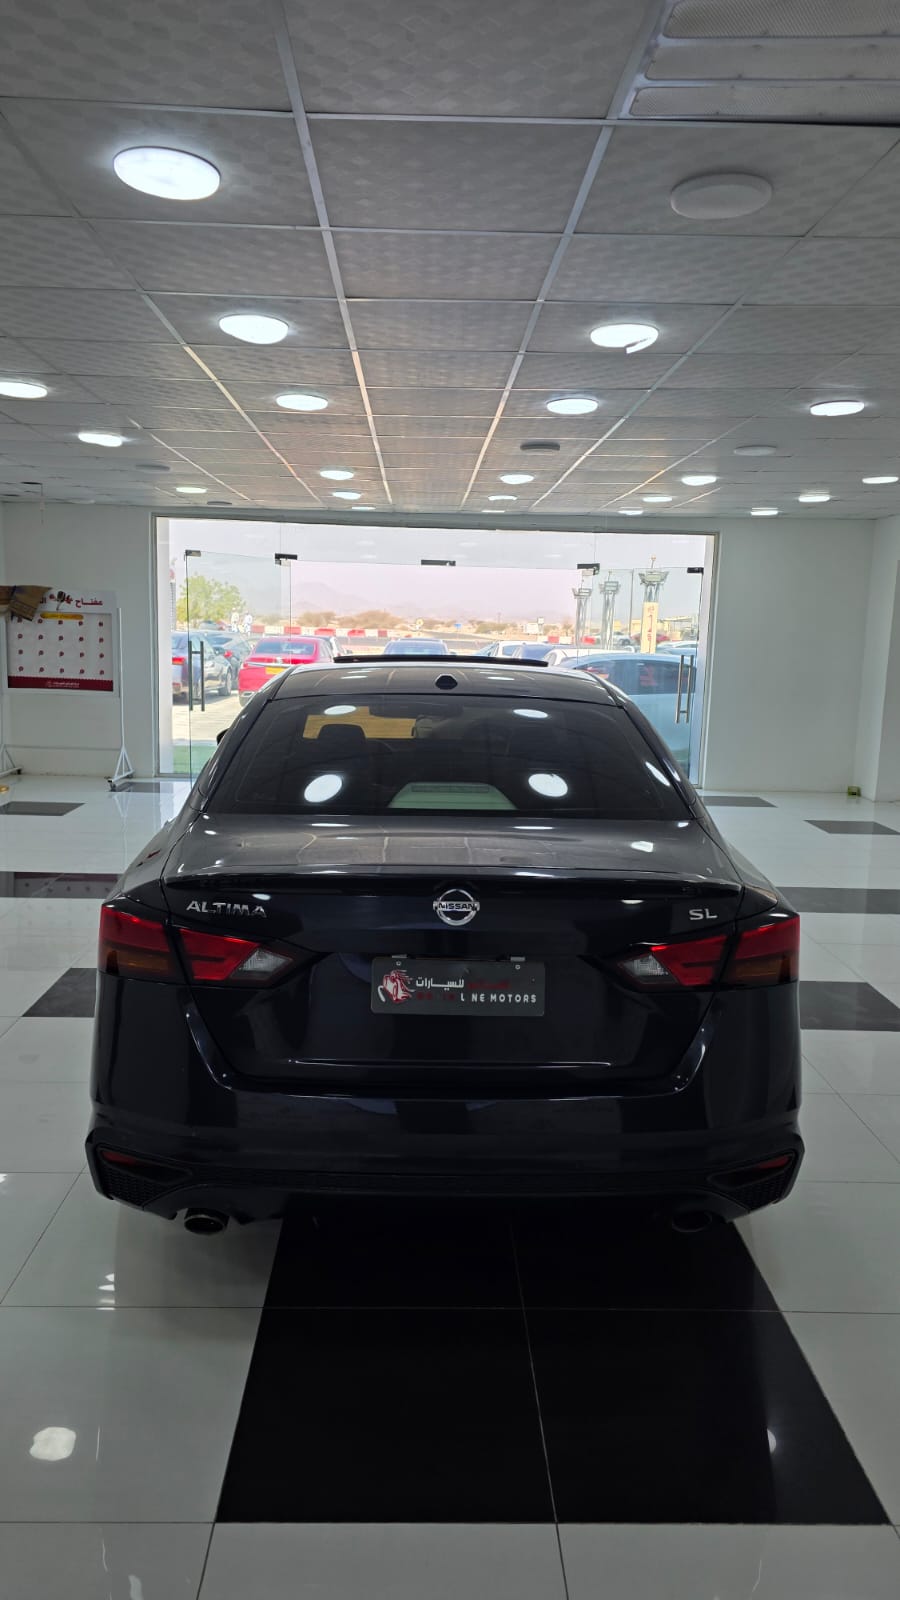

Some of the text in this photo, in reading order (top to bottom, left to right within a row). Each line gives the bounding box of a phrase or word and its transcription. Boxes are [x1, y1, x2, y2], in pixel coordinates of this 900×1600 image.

[186, 900, 267, 918] ALTIMA
[438, 902, 475, 911] NISSAN
[689, 908, 718, 920] SL
[415, 977, 465, 991] للسيارات
[460, 993, 485, 1003] LNE
[490, 994, 537, 1004] MOTORS
